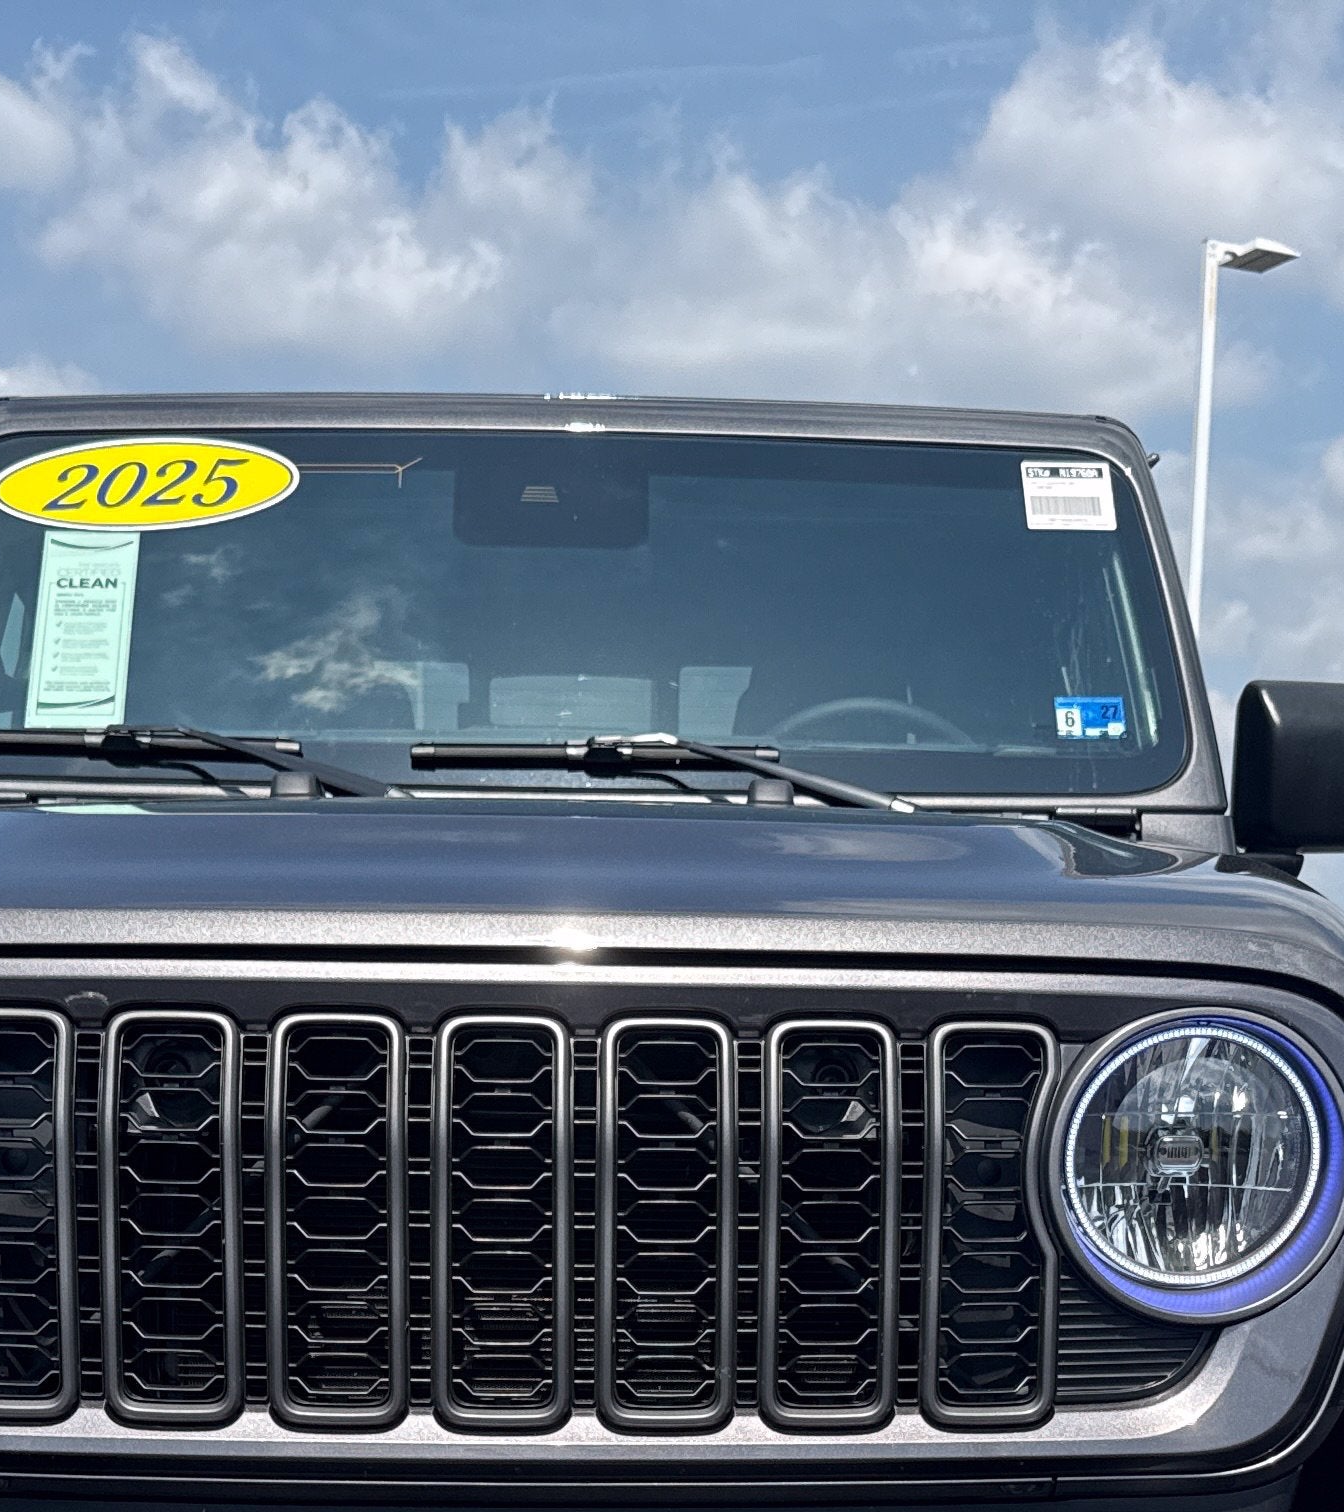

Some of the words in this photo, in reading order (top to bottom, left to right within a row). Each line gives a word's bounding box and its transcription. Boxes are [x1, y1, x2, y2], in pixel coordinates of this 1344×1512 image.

[42, 458, 250, 512] 2025
[56, 577, 118, 589] CLEAN
[1065, 710, 1075, 728] 6
[1101, 705, 1118, 720] 27
